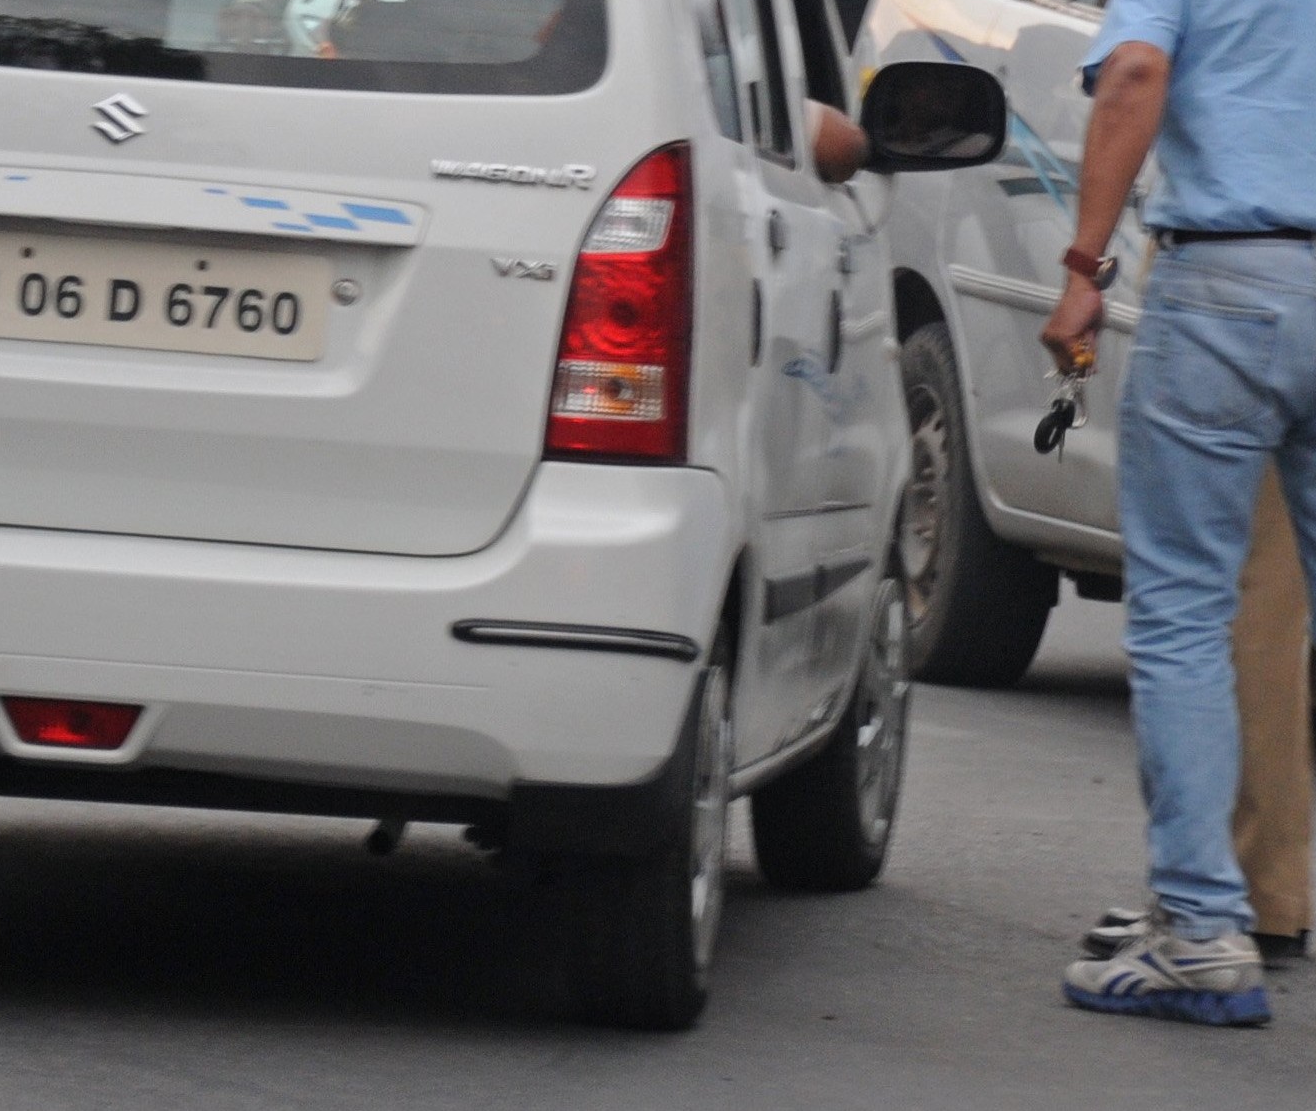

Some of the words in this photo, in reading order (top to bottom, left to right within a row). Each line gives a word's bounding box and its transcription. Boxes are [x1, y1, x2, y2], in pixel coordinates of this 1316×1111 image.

[19, 272, 84, 319] 06
[108, 279, 142, 322] D
[165, 282, 300, 336] 6760
